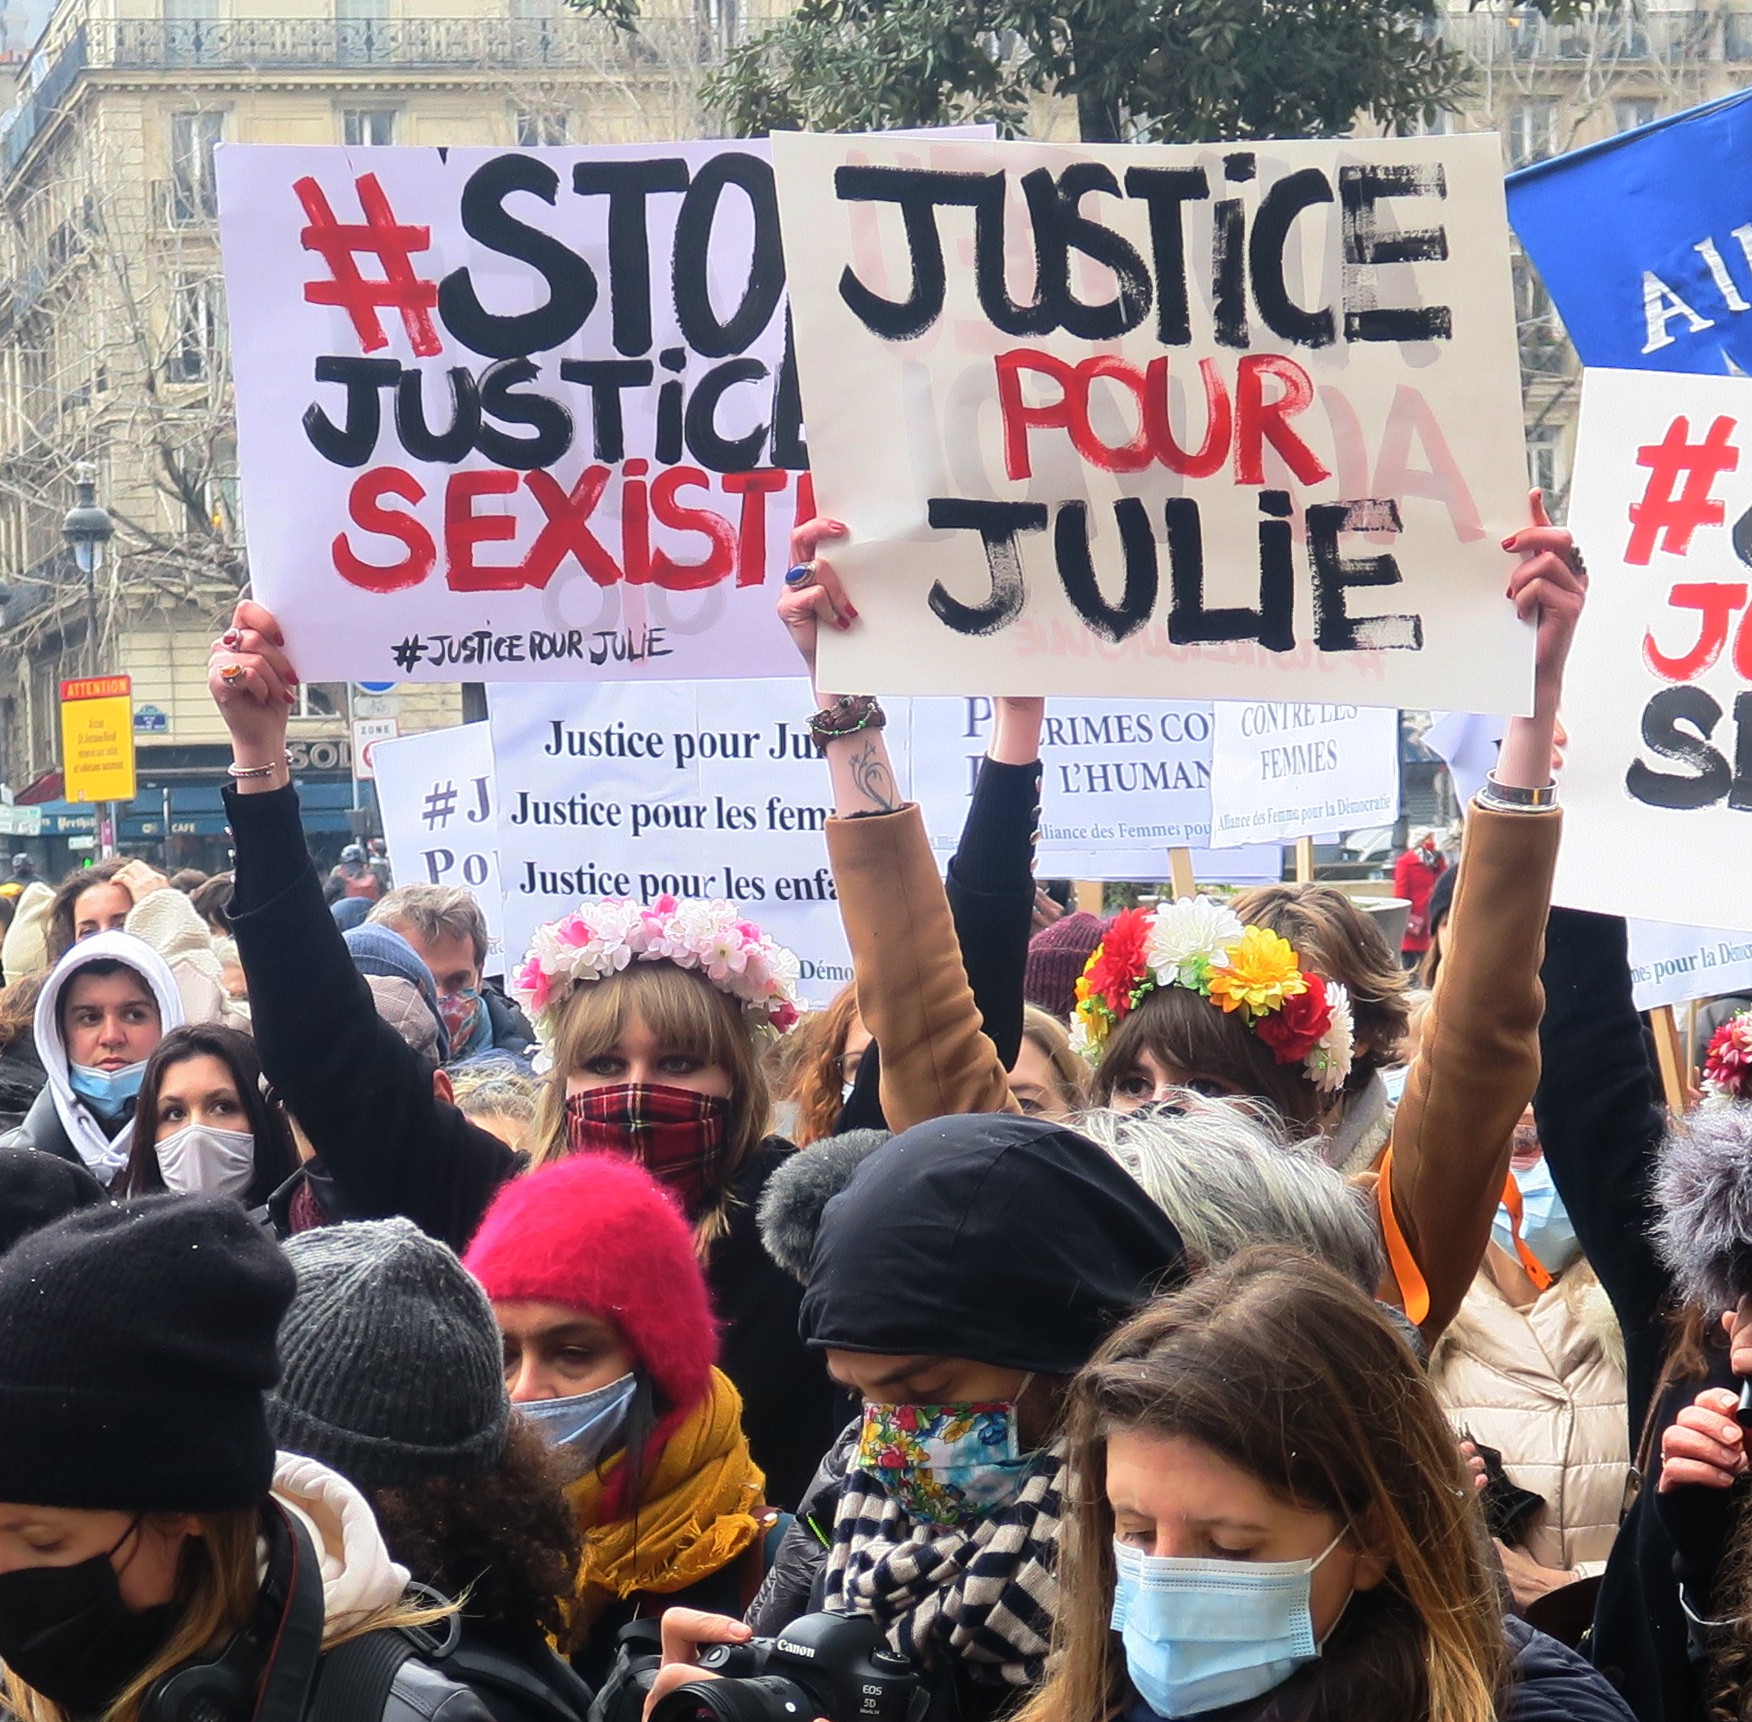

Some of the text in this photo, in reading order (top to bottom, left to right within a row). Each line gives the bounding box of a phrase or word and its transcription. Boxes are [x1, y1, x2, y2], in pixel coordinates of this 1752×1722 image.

[292, 151, 788, 358] #STO
[995, 350, 1332, 487] POUR
[66, 680, 127, 697] ATTENTION
[360, 725, 391, 735] ZONE
[1038, 712, 1154, 746] RIMES
[1241, 702, 1315, 737] CONTRE
[544, 720, 665, 760] Justice
[675, 728, 760, 769] pour
[1260, 739, 1339, 781] FEMMES
[511, 791, 622, 828] Justice
[631, 803, 708, 837] pour
[715, 797, 757, 832] les
[1038, 823, 1088, 840] lliance
[1091, 823, 1115, 839] des
[1117, 822, 1181, 839] Femmes
[1217, 812, 1251, 832] Alliance
[1253, 809, 1266, 827] des
[1301, 804, 1324, 825] pour
[1325, 800, 1336, 817] la
[519, 860, 631, 896] Justice
[641, 872, 716, 903] pour
[724, 867, 765, 901] les
[1652, 954, 1699, 984] pour
[1700, 946, 1717, 969] la
[776, 1638, 816, 1659] Canon
[862, 1684, 883, 1696] EOS
[863, 1698, 877, 1708] 5D
